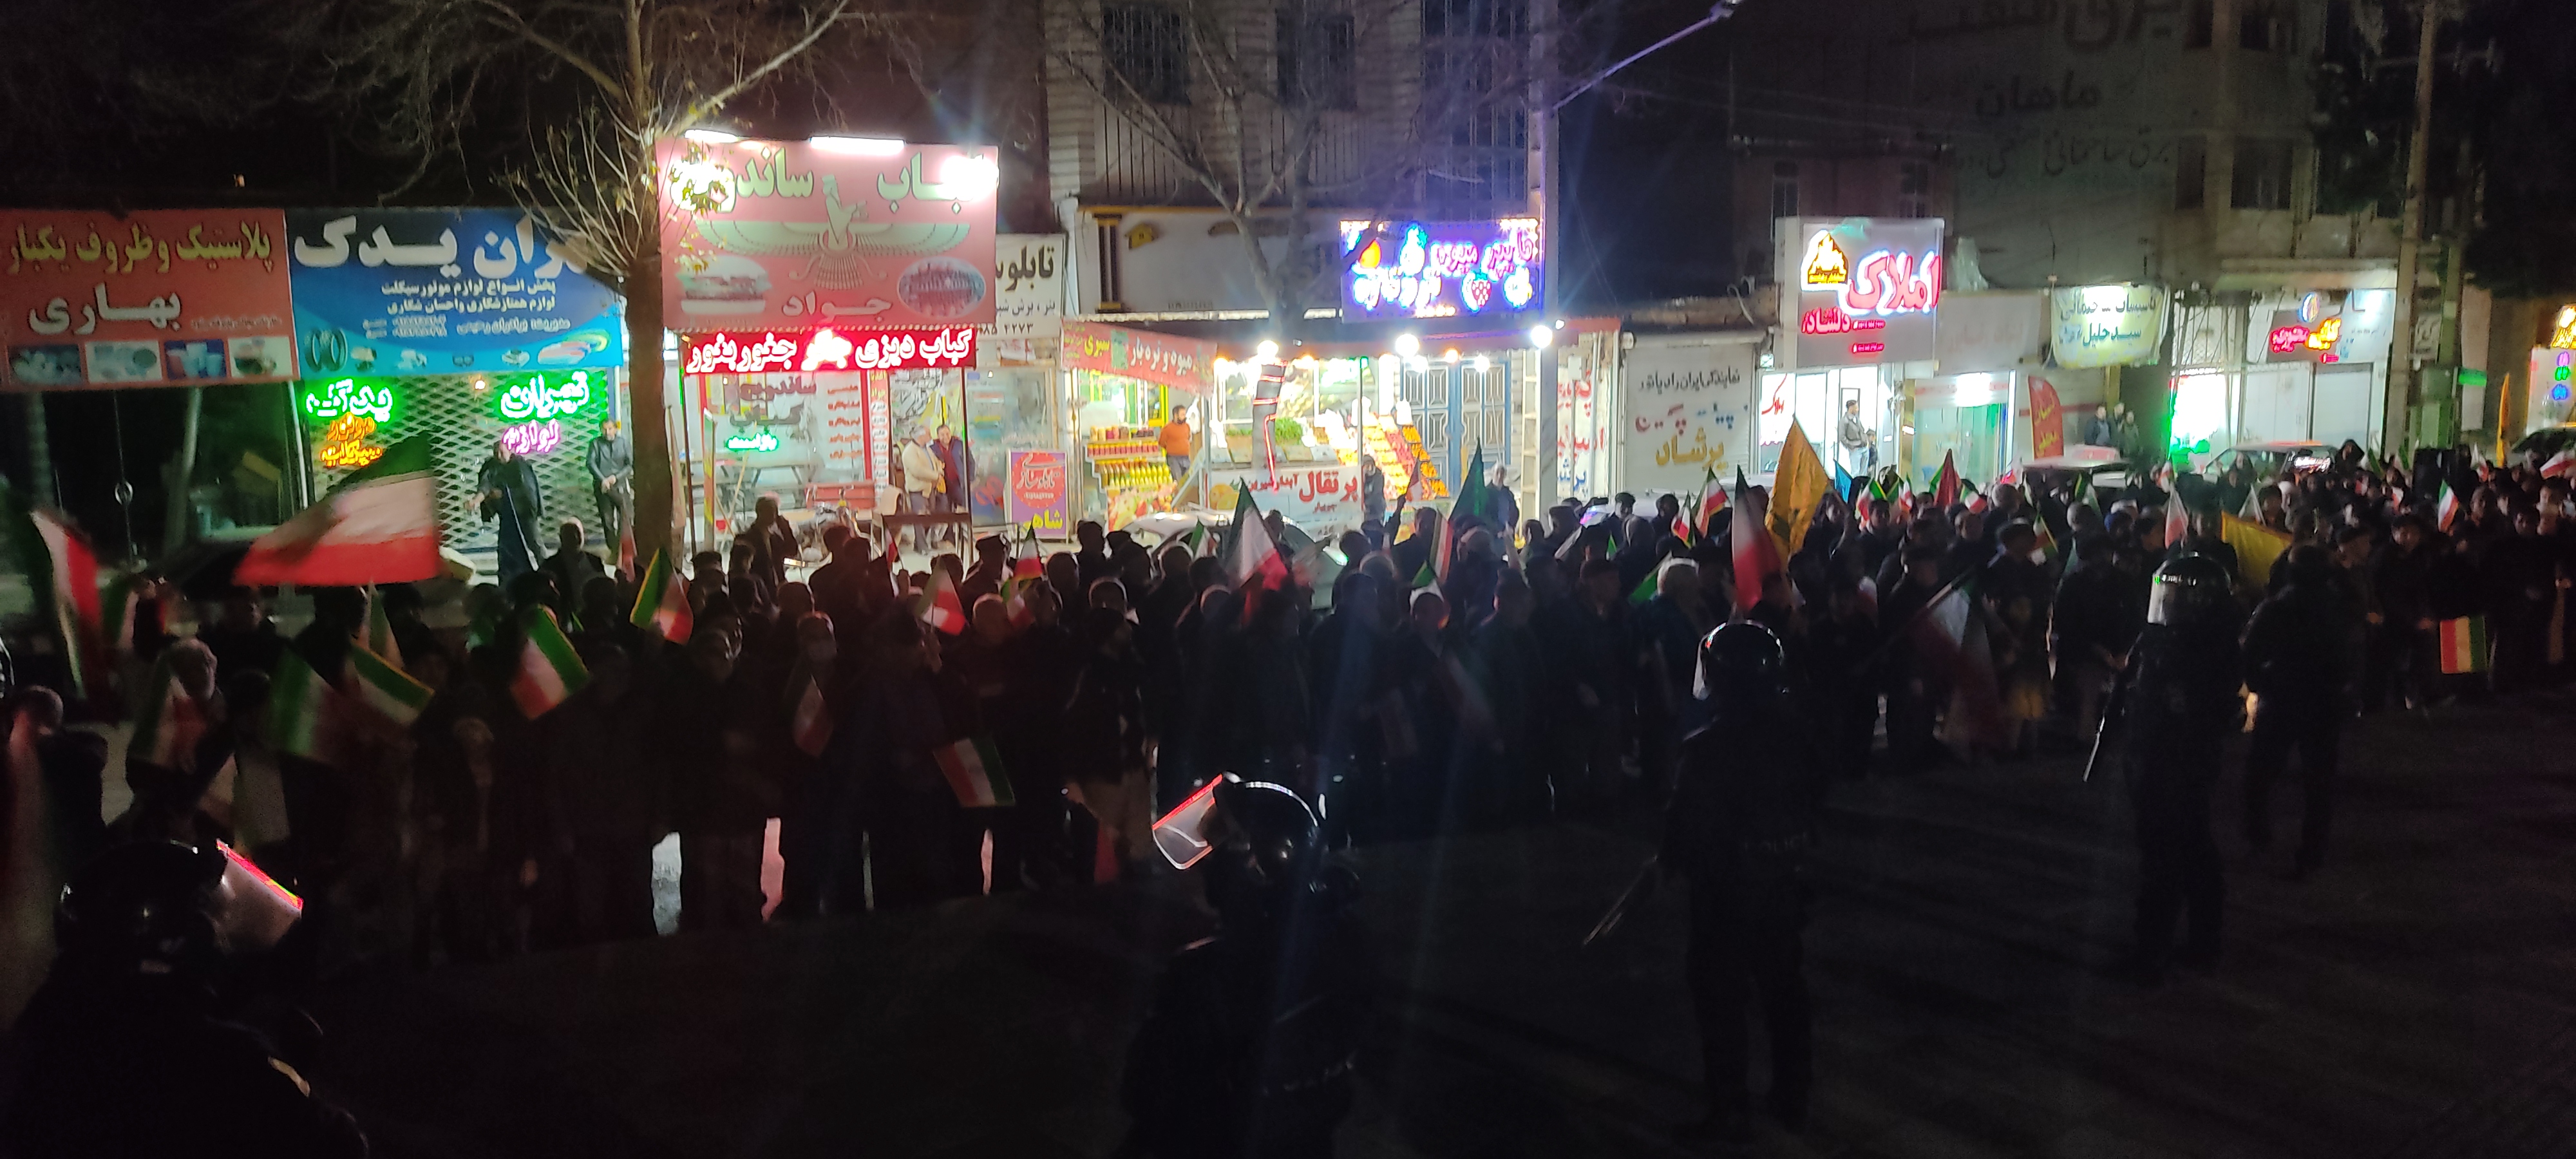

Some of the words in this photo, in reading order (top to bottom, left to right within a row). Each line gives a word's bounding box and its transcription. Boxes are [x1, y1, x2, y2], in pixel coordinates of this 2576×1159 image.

[878, 152, 999, 215] باب
[7, 222, 67, 274] یکبار
[176, 220, 272, 273] پلاستیک
[294, 215, 462, 279] یدک
[453, 279, 484, 297] لوازم
[487, 279, 525, 296] انواع
[527, 278, 556, 296] پخش
[1843, 252, 1941, 312] املاک
[28, 282, 183, 335] بهاری
[387, 298, 422, 315] شکاری
[529, 296, 556, 312] لوازم
[782, 291, 893, 325] جواد
[1012, 299, 1034, 316] برش
[1802, 306, 1851, 334] دلشاد
[920, 328, 973, 367] کباب
[1084, 335, 1111, 358] سبزی
[2111, 325, 2143, 348] سید
[855, 334, 914, 369] دیزی
[1162, 350, 1169, 373] و
[1170, 350, 1193, 376] میوه
[740, 376, 817, 402] ساندویچ
[1680, 371, 1705, 392] ایران
[1705, 365, 1741, 390] نمایندگی
[501, 371, 590, 419] تهران
[730, 402, 805, 434] کباب
[502, 418, 560, 454] لوازم
[320, 439, 383, 468] سیکلت
